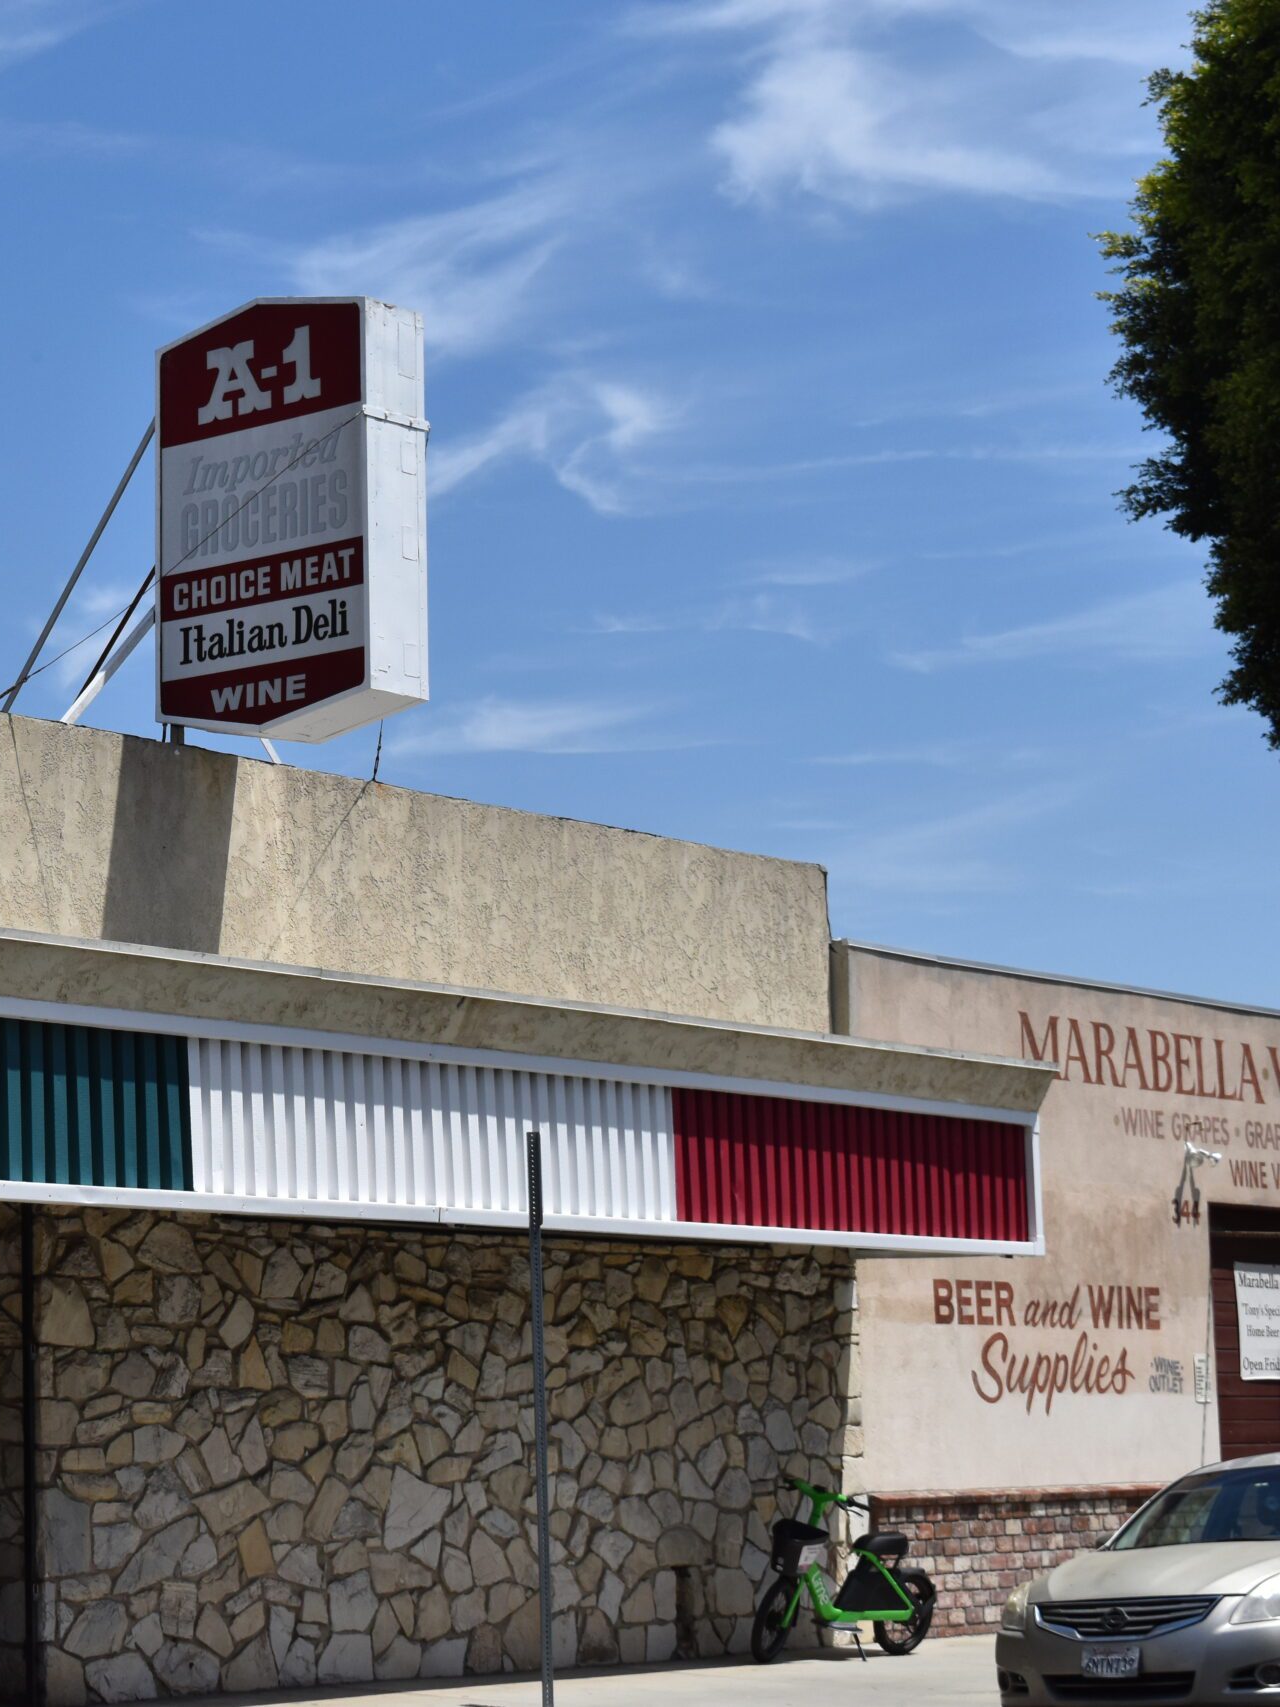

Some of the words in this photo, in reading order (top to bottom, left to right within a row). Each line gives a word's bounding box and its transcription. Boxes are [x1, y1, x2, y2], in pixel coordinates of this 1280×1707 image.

[198, 325, 321, 425] A-1
[182, 422, 343, 497] Imported
[180, 469, 348, 560] GROCERIES
[174, 566, 271, 612] CHOICE
[280, 547, 356, 594] MEAT
[180, 618, 287, 665] Italian
[292, 599, 350, 645] Deli
[211, 673, 306, 713] WINE
[1018, 1010, 1265, 1104] MARABELLA
[1121, 1106, 1165, 1139] WINE
[1171, 1111, 1230, 1146] GRAPES
[1229, 1159, 1268, 1189] WINE
[1172, 1198, 1201, 1225] 344
[1238, 1272, 1279, 1290] Marabella
[932, 1278, 1016, 1326] BEER
[1024, 1285, 1082, 1329] and
[1087, 1284, 1160, 1331] WINE
[1246, 1324, 1265, 1337] Home
[971, 1331, 1135, 1416] Supplies
[1149, 1374, 1184, 1394] OUTLET
[1153, 1356, 1181, 1377] WINE
[1243, 1357, 1262, 1374] Open
